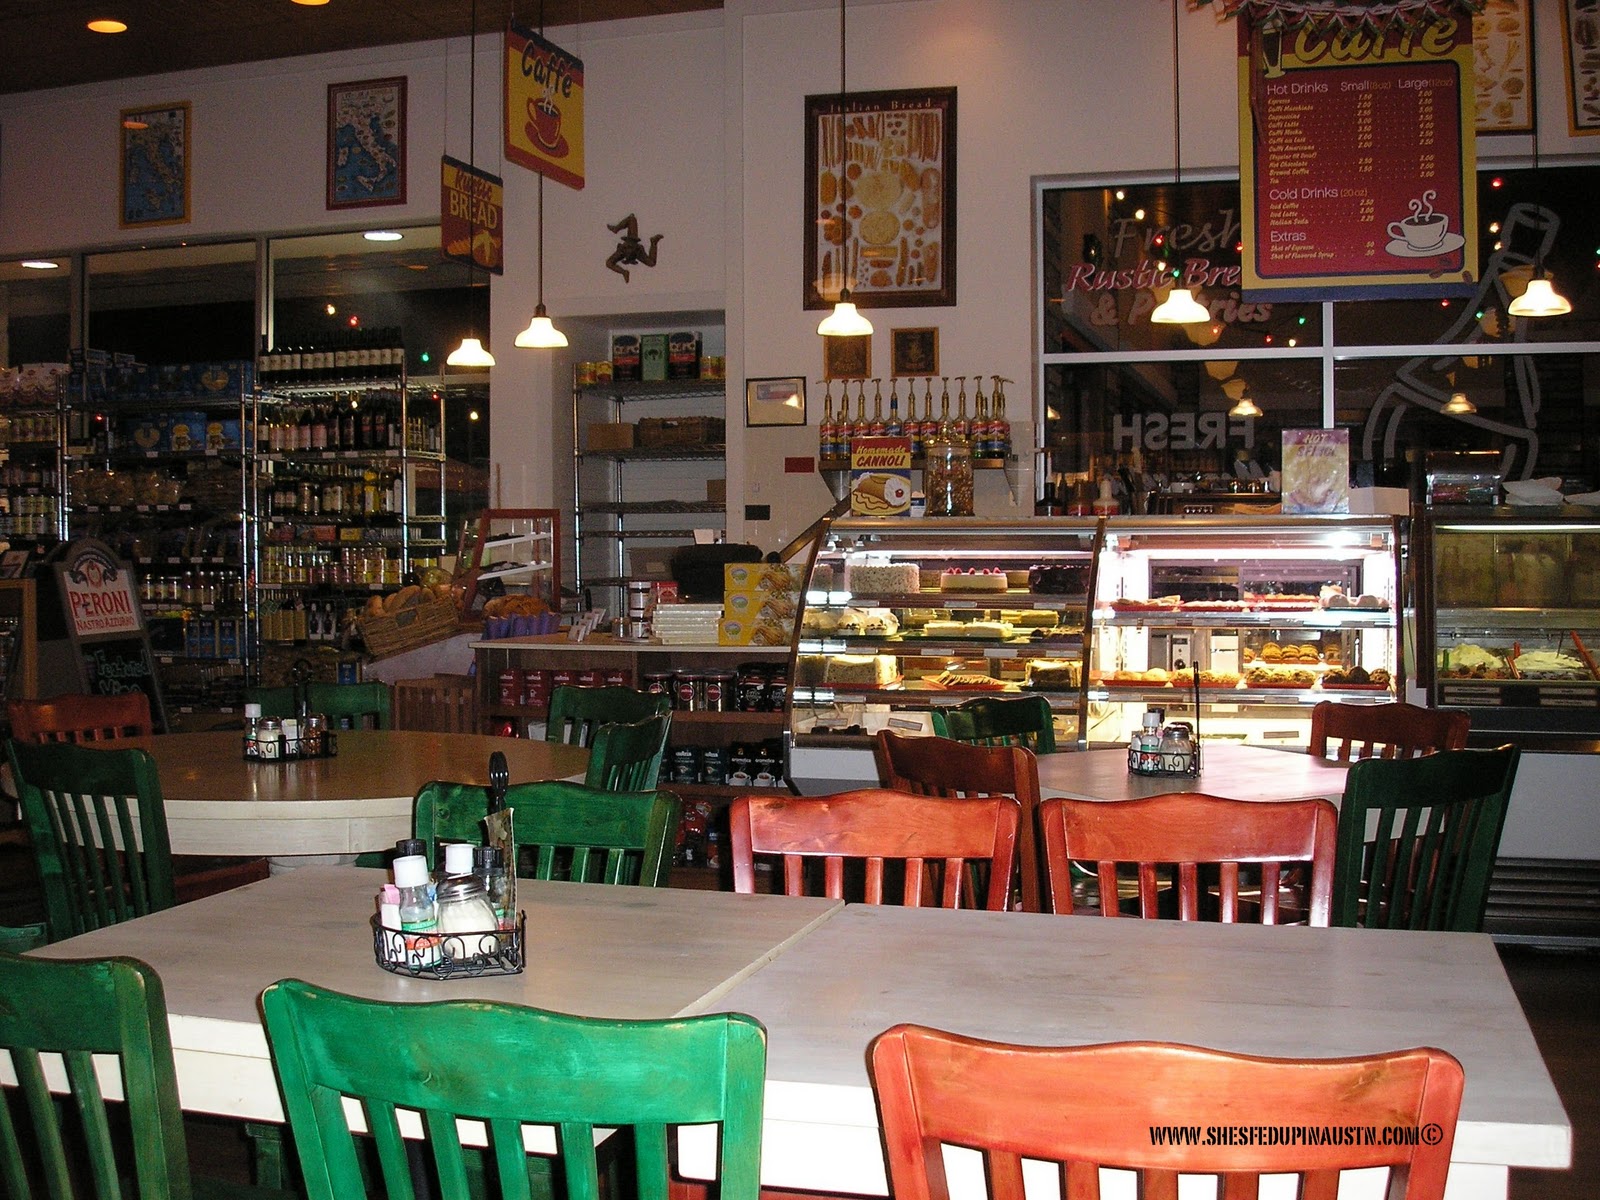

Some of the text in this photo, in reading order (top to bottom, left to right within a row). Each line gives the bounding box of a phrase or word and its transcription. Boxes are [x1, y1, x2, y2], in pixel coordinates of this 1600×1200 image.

[1267, 84, 1288, 96] Hot
[1291, 82, 1329, 94] Drinks
[830, 97, 932, 114] Italian Bread
[1269, 188, 1298, 201] Cold
[1301, 187, 1338, 200] Drinks
[449, 189, 498, 229] BREAD
[1270, 230, 1307, 243] Extras
[1067, 257, 1241, 292] Rustic Bre
[1090, 289, 1274, 326] & Pries
[1303, 433, 1329, 443] HOT
[856, 444, 906, 454] Homemade
[856, 455, 906, 467] CANNOLI
[69, 590, 132, 619] PERONI
